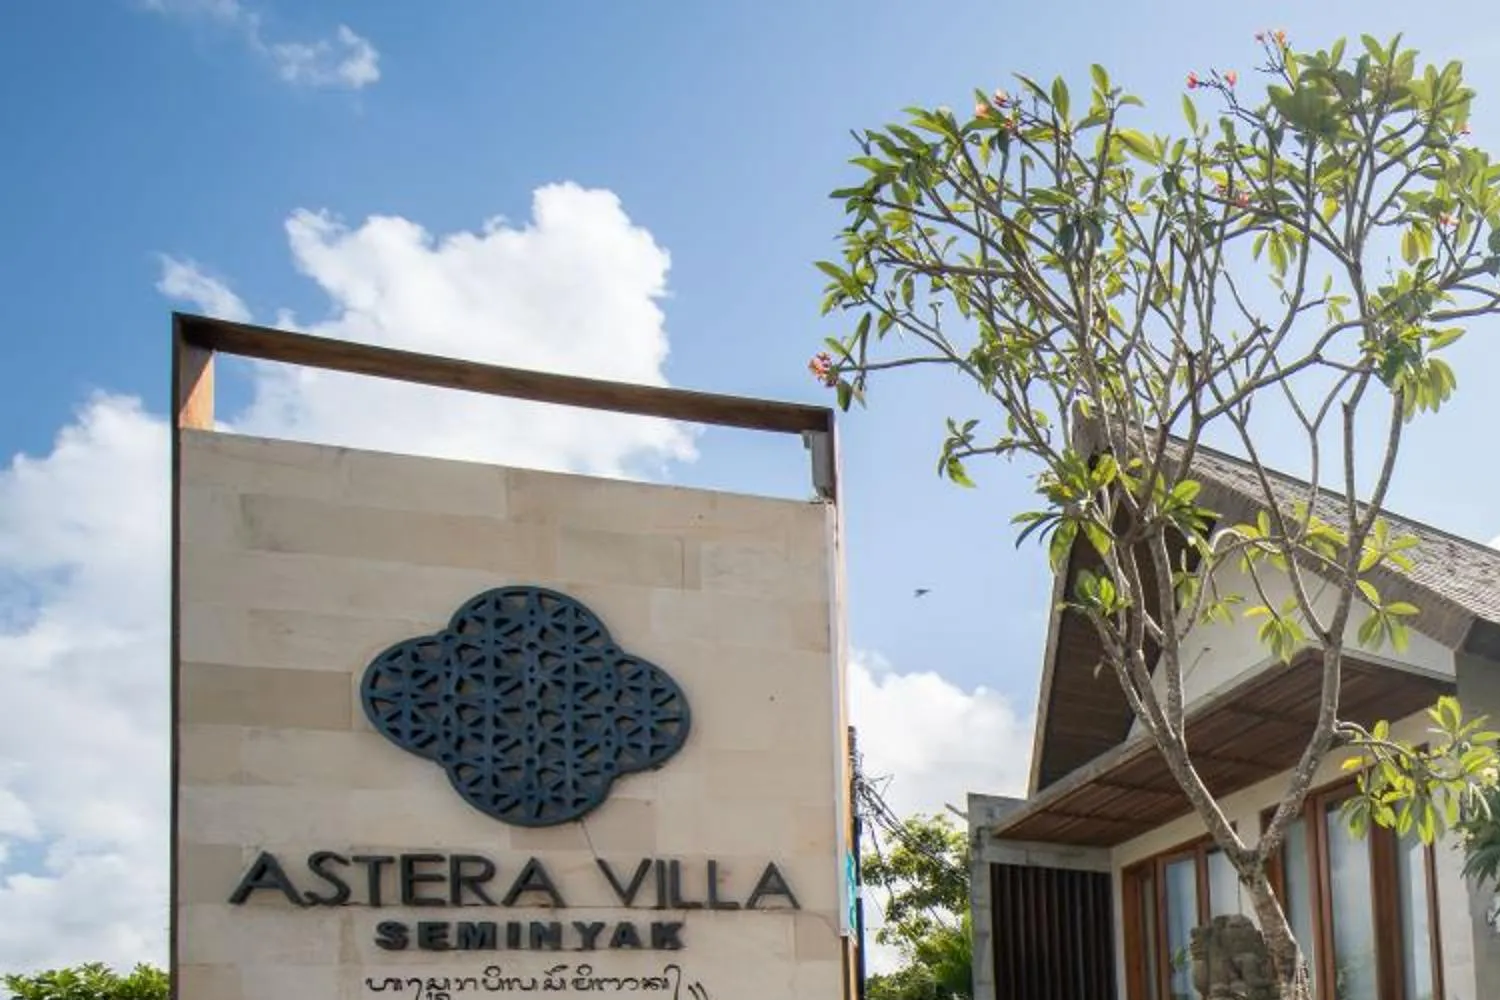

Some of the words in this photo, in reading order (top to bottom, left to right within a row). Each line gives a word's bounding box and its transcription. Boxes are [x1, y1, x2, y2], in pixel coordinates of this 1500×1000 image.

[230, 851, 568, 909] ASTERA
[596, 857, 802, 911] VILLA
[375, 919, 688, 951] SEMINYAK
